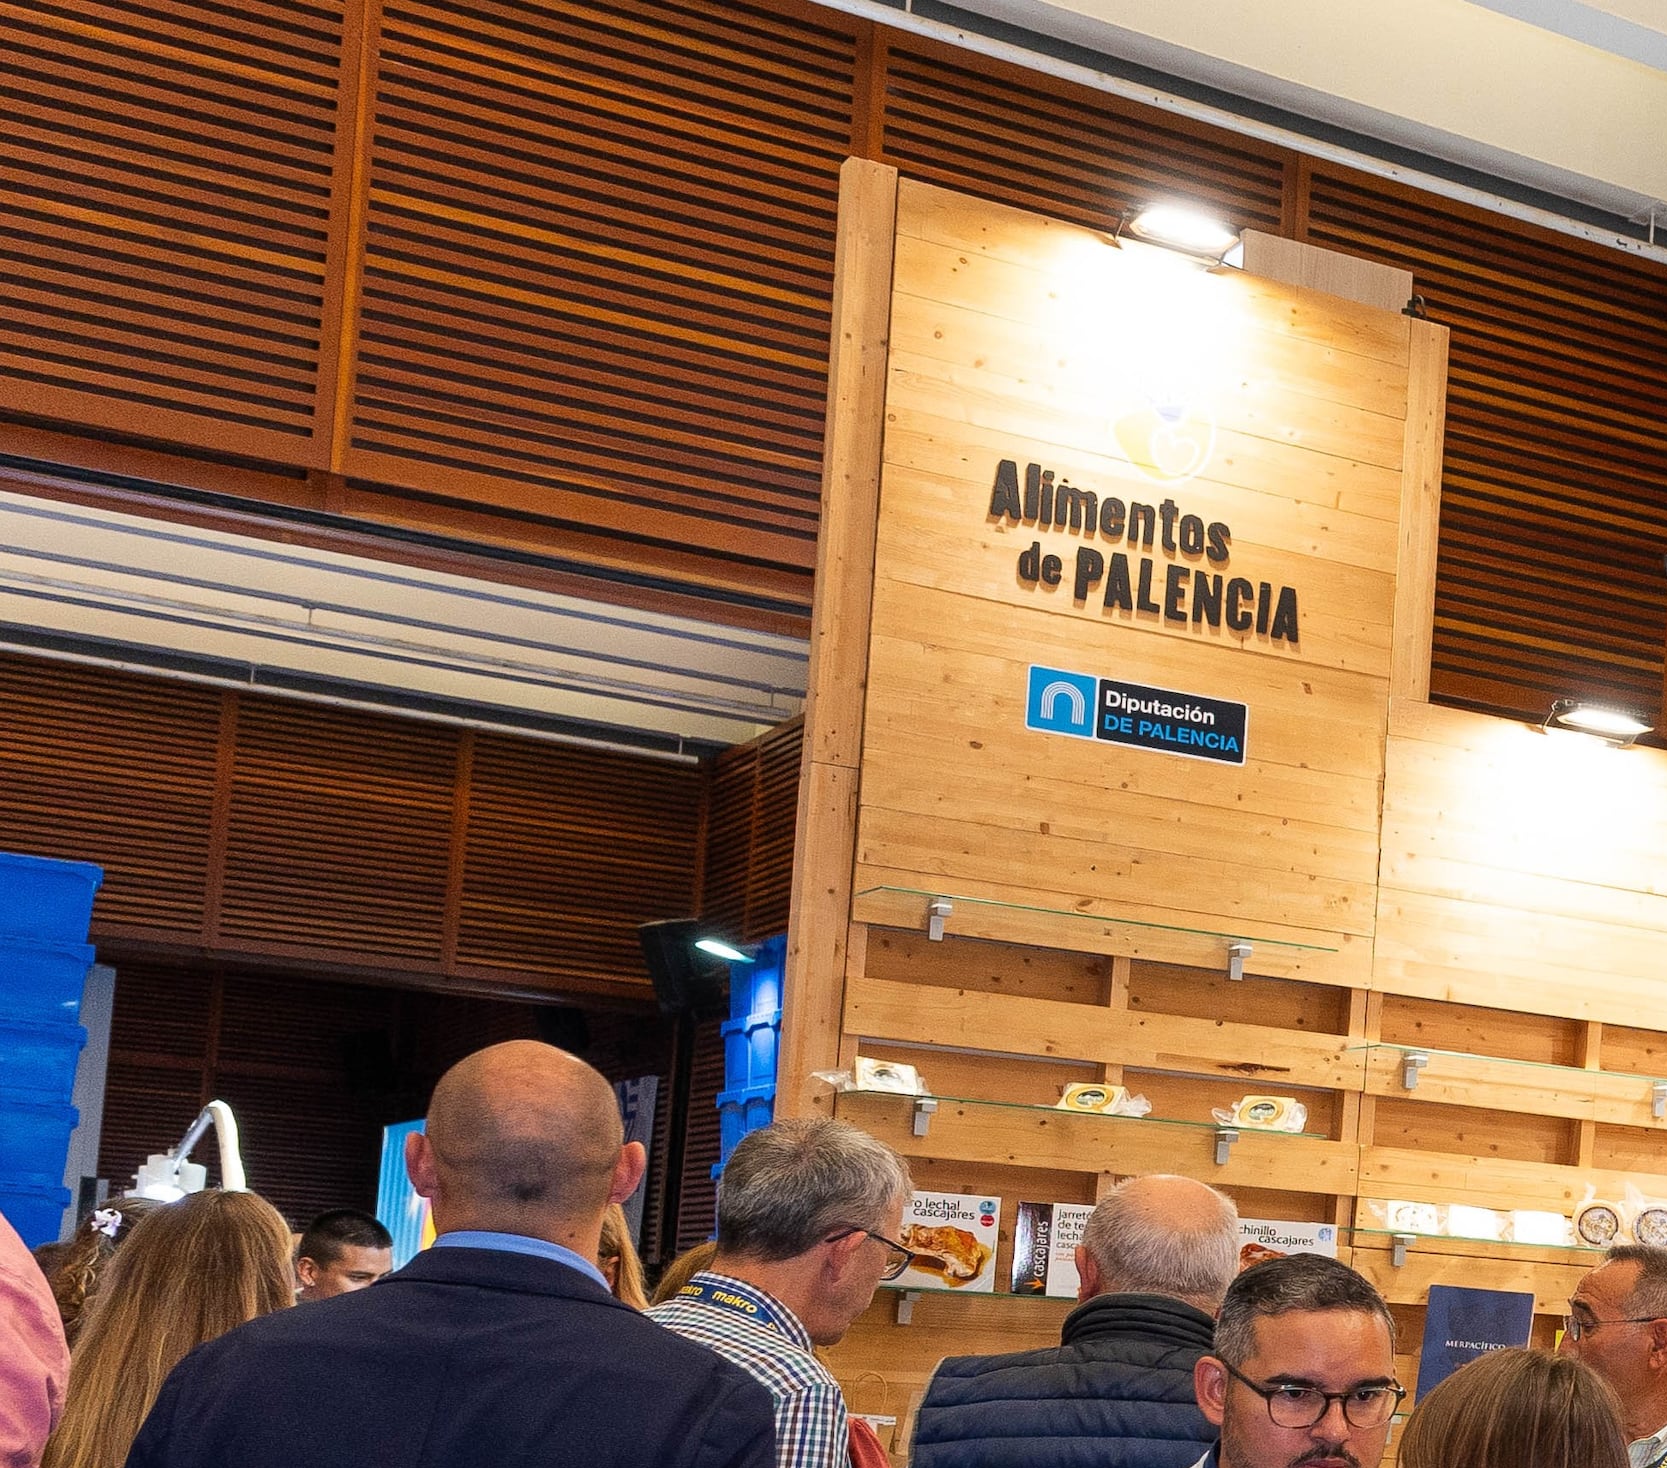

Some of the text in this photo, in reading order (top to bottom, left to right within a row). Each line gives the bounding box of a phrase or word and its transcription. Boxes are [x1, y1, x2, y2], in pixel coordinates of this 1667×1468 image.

[990, 458, 1231, 562] Alimentos
[1018, 541, 1301, 643] de PALENCIA
[1104, 689, 1216, 726] Diputación
[1103, 714, 1240, 753] DE PALENCIA
[913, 1208, 976, 1221] cascajares
[925, 1198, 960, 1211] lechal
[1057, 1220, 1072, 1230] de
[1258, 1233, 1314, 1248] cascajares
[1032, 1220, 1050, 1279] cascajares
[711, 1289, 758, 1315] makro
